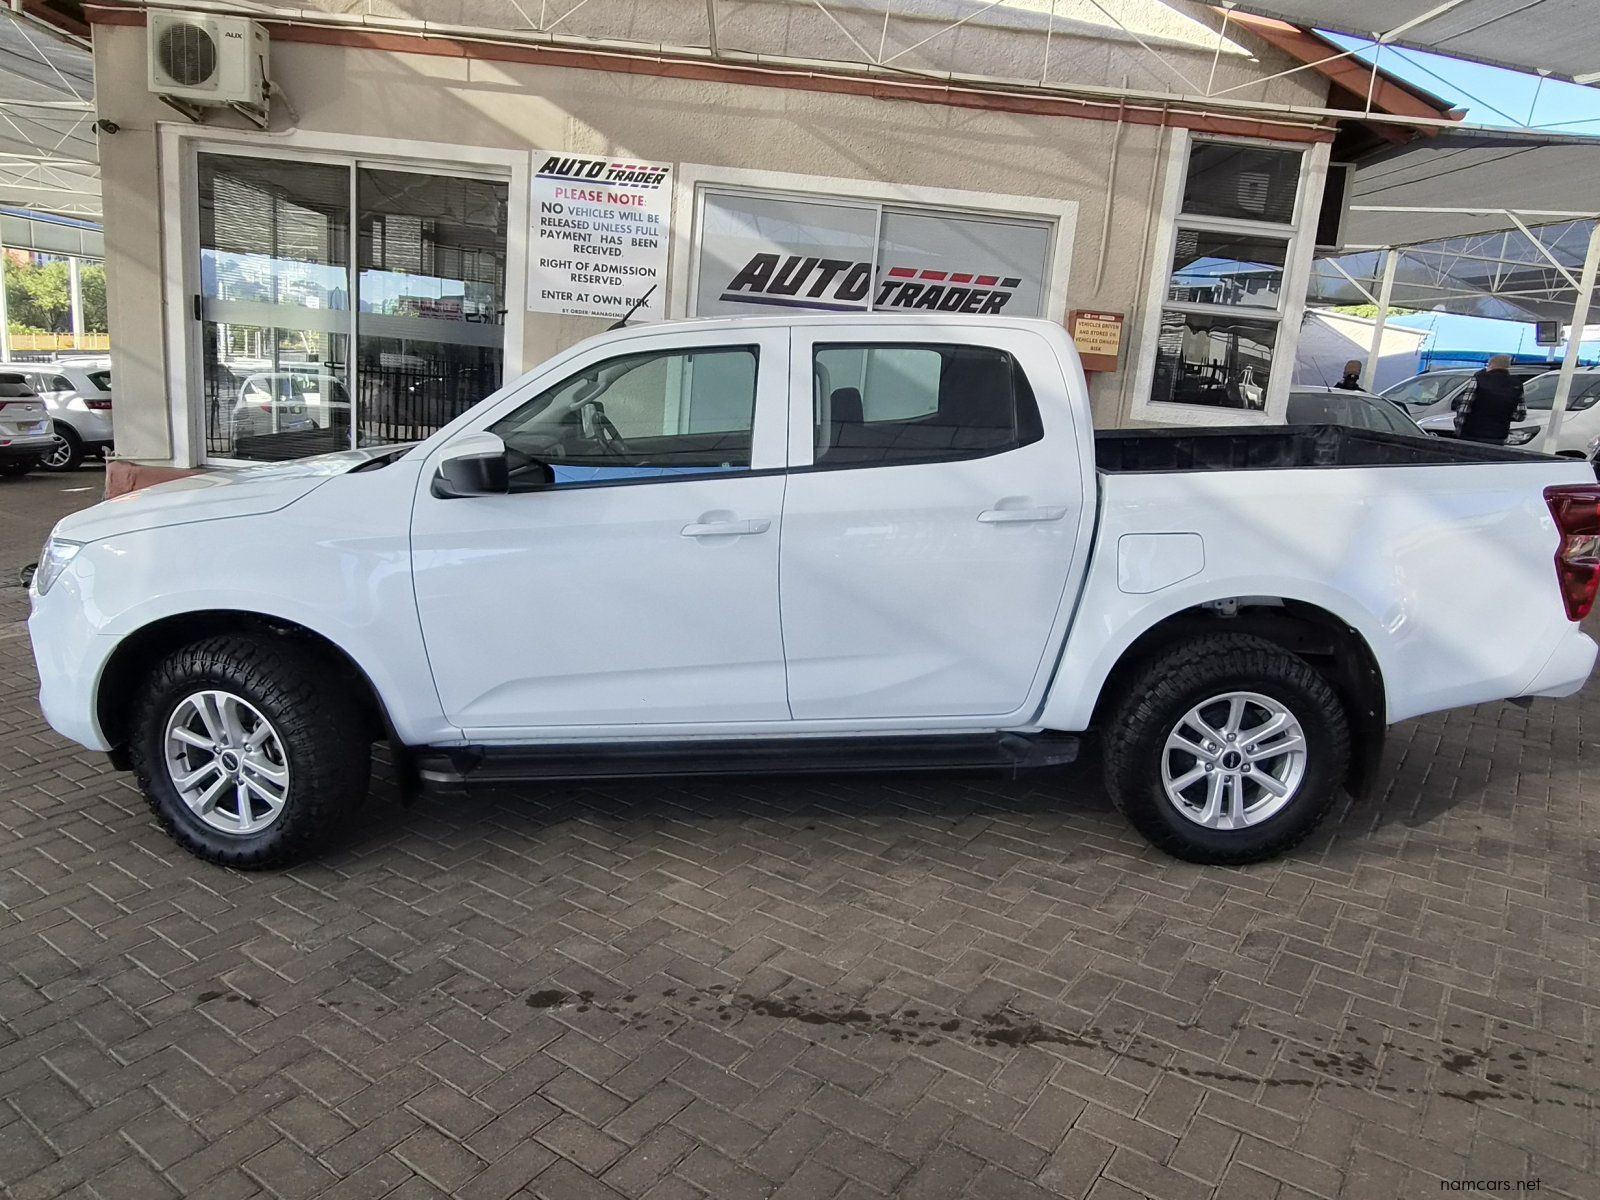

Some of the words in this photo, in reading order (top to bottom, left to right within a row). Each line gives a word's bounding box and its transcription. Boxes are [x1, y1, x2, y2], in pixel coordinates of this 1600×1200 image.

[538, 156, 607, 178] AUTO
[605, 168, 666, 185] TRADER
[555, 187, 602, 202] PLEASE
[607, 193, 647, 206] NOTE:
[541, 202, 563, 214] NO
[567, 206, 615, 219] VEHICLES
[619, 211, 643, 222] WILL
[647, 214, 660, 224] BE
[540, 217, 589, 230] RELEASED
[593, 222, 632, 234] UNLESS
[635, 226, 659, 236] FULL
[540, 229, 592, 242] PAYMENT
[600, 235, 623, 245] HAS
[631, 238, 658, 248] BEEN
[573, 244, 624, 257] RECEIVED.
[539, 258, 572, 269] RIGHT
[575, 262, 590, 271] OF
[592, 263, 657, 277] ADMISSION
[570, 273, 624, 286] RESERVED.
[726, 252, 880, 302] AUTO
[874, 280, 1012, 315] TRADER
[541, 290, 573, 301] ENTER
[577, 293, 590, 302] AT
[592, 294, 622, 306] OWN
